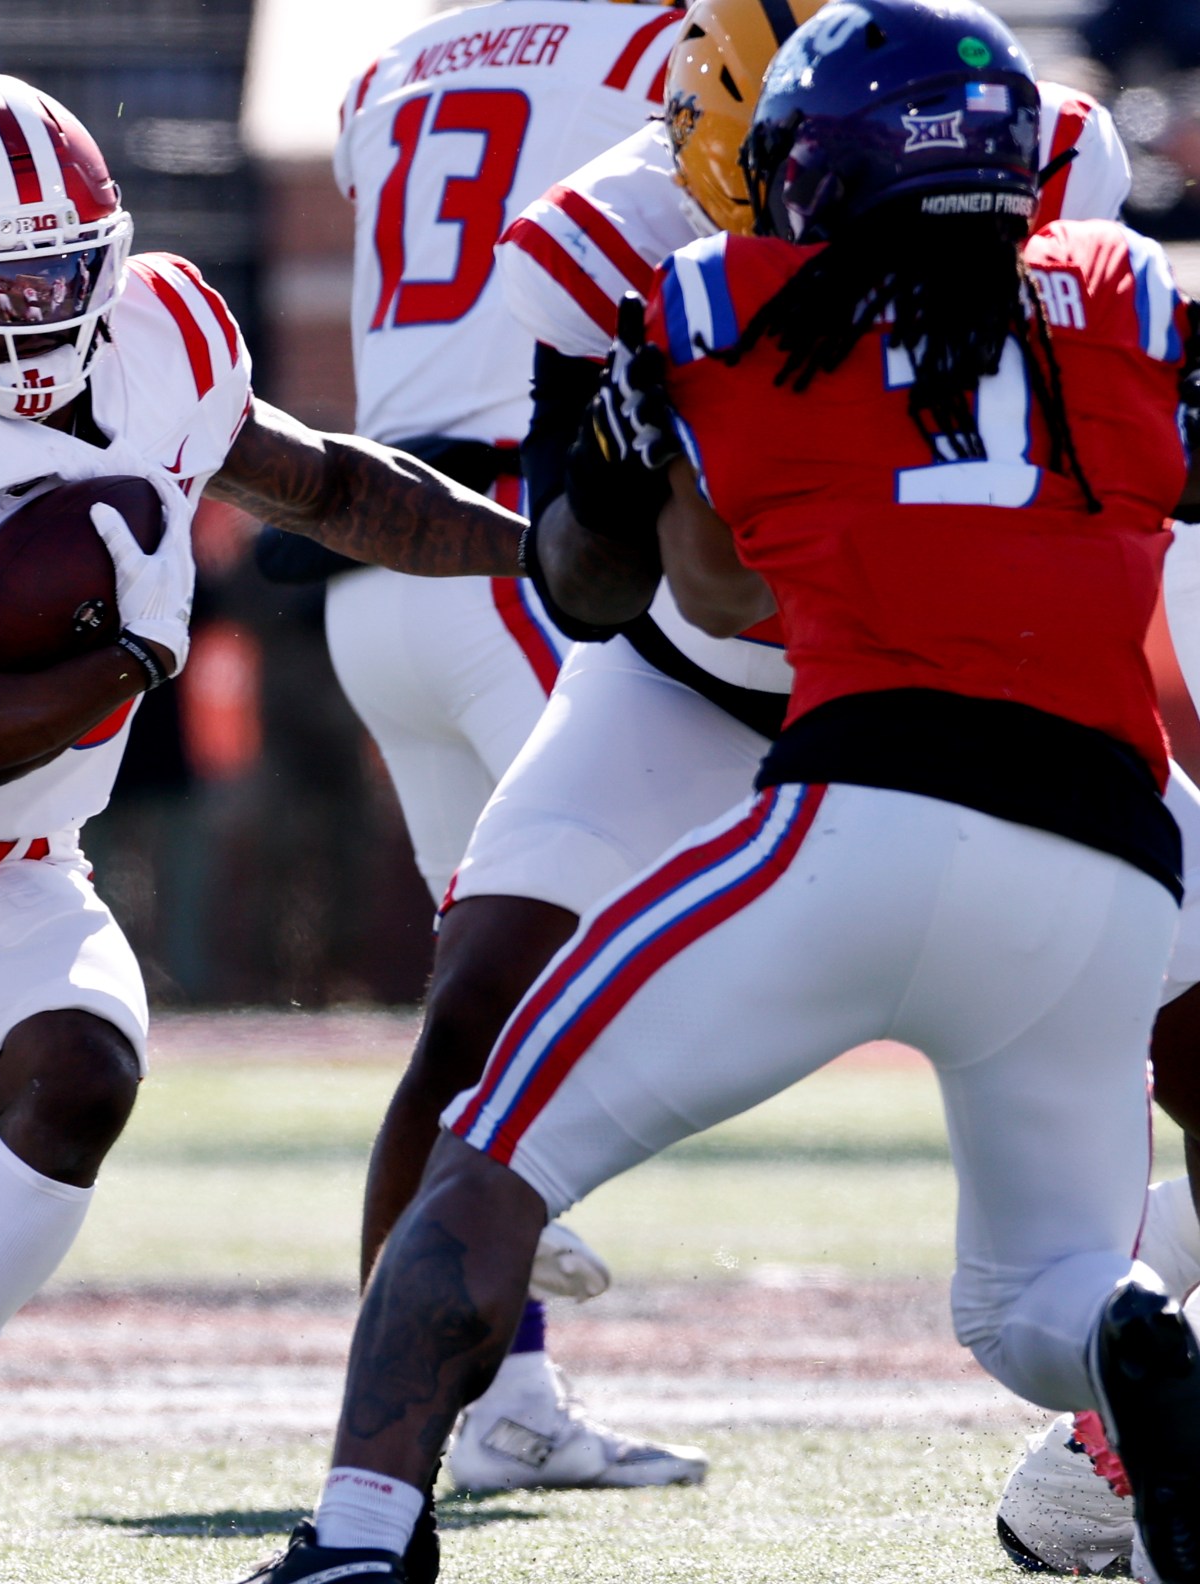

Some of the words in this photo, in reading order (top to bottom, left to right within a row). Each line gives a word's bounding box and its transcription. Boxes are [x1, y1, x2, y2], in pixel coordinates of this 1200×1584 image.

[402, 22, 571, 87] NUSSMEIER
[368, 86, 532, 333] 13
[921, 192, 993, 214] HORNED
[995, 192, 1033, 216] FROGS
